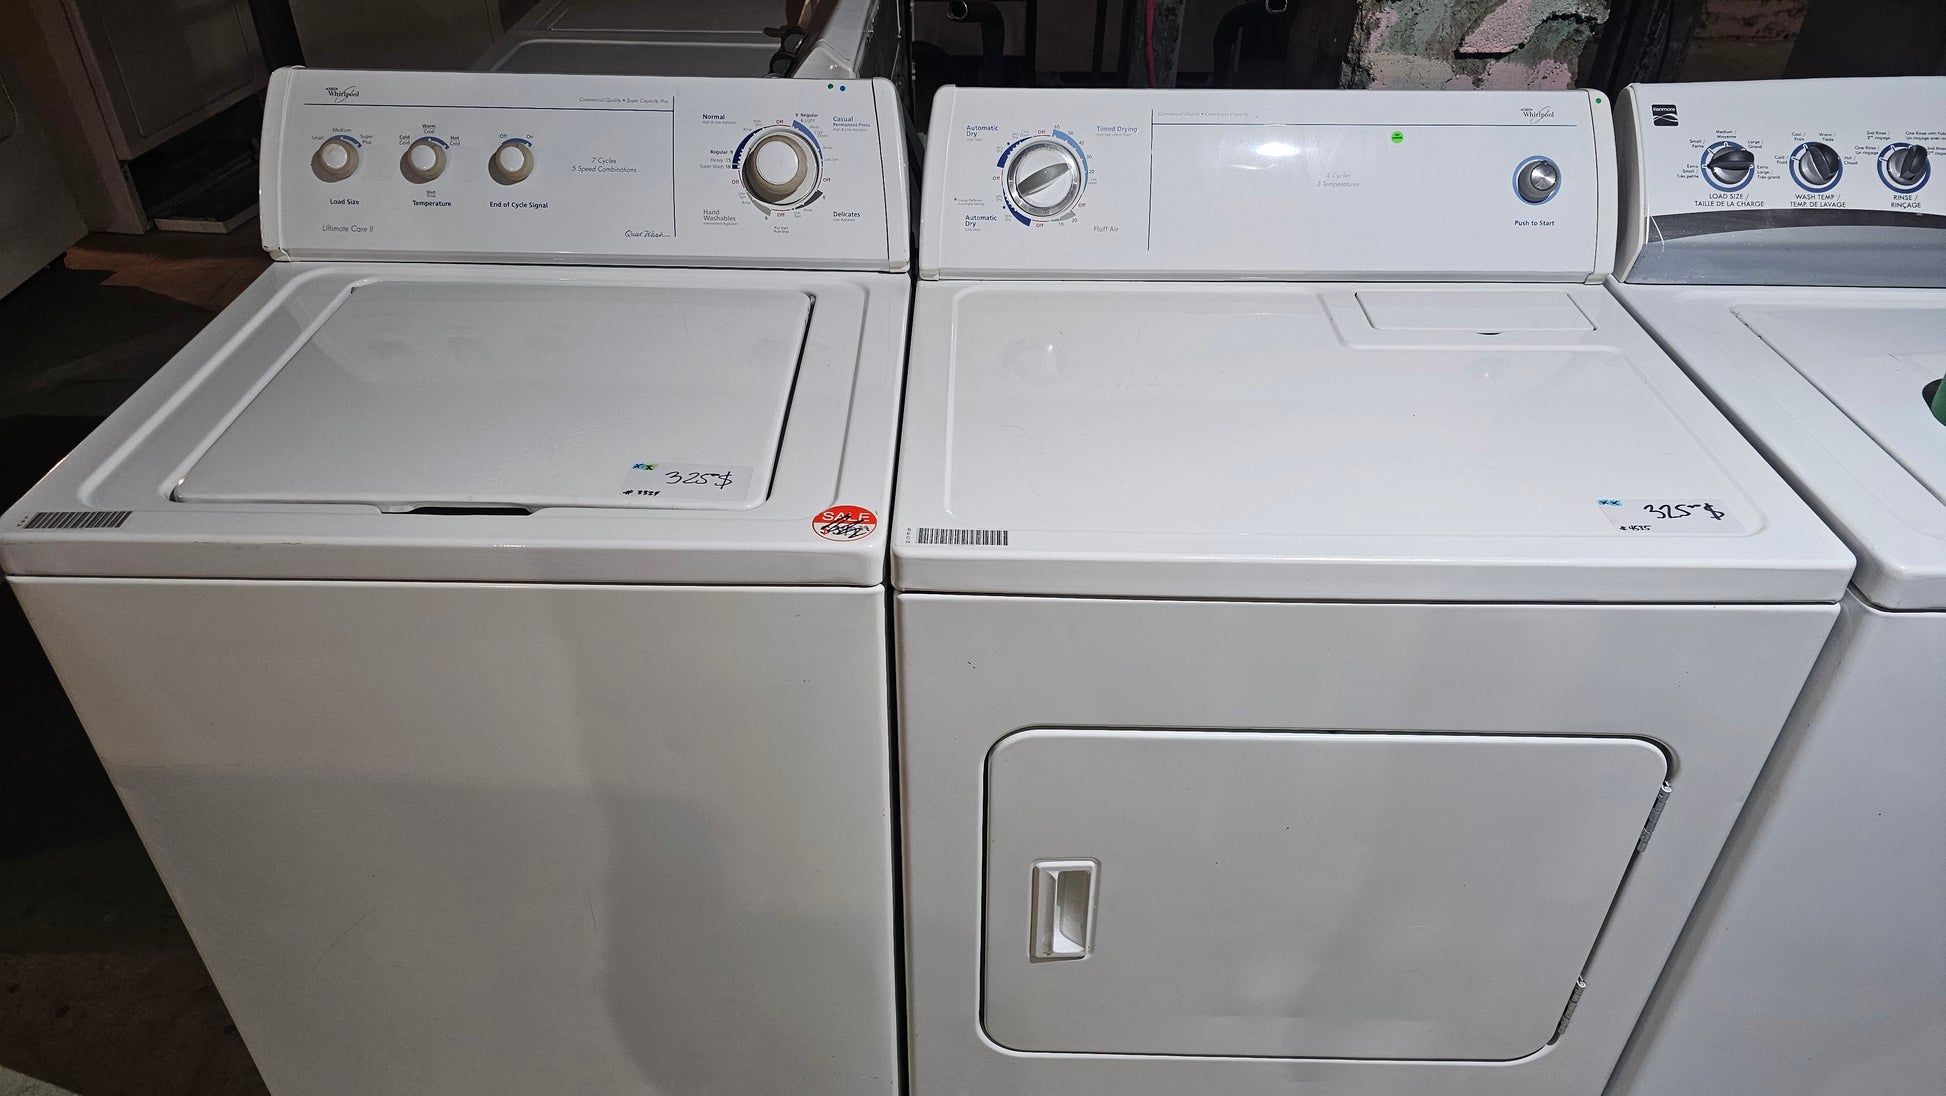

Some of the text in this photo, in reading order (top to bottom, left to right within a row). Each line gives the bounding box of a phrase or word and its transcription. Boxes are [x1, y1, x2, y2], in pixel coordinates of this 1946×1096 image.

[328, 89, 360, 99] Whirlpool
[1523, 111, 1554, 119] Whirlpool
[1116, 125, 1138, 133] Drying
[597, 157, 617, 165] Cycles
[577, 165, 597, 174] Speed
[1332, 171, 1351, 179] Cycles
[1322, 180, 1360, 188] Temperatures
[412, 200, 452, 208] Temperature
[511, 202, 528, 210] Cycle
[529, 202, 549, 210] Signal
[322, 223, 349, 232] Ultimate
[350, 225, 367, 233] Care
[965, 220, 977, 228] Dry
[624, 229, 671, 238] Quiet Wash
[822, 511, 870, 522] SALE
